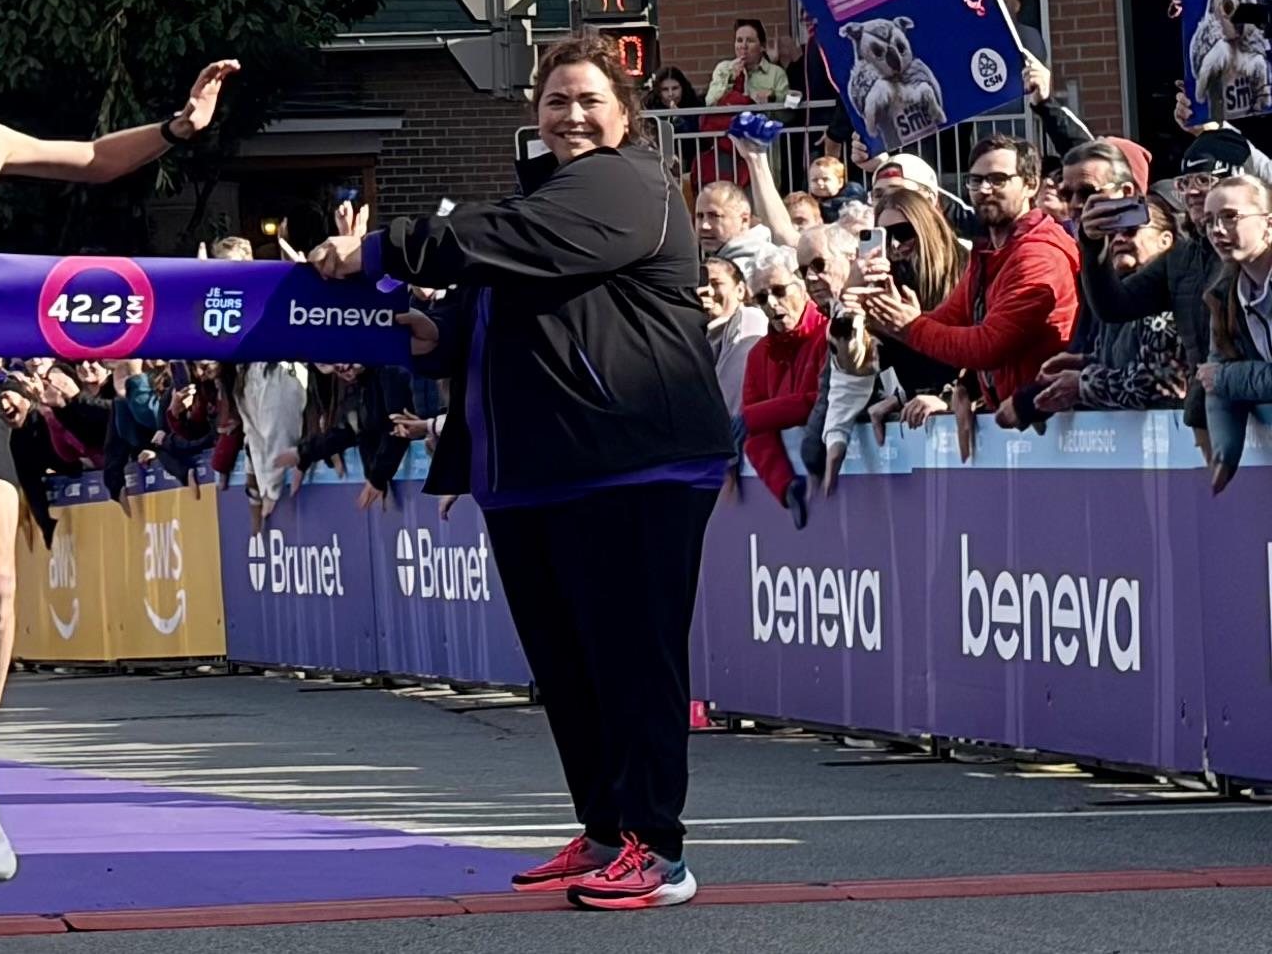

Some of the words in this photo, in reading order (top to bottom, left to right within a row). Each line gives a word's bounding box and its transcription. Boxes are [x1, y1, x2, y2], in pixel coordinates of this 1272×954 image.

[48, 293, 123, 324] 42.2
[125, 294, 145, 324] KM
[204, 298, 243, 309] COURS
[205, 287, 221, 298] JE
[288, 299, 394, 327] beneva
[203, 309, 242, 337] QC
[144, 518, 183, 582] aws
[269, 529, 344, 596] Brunet
[417, 528, 490, 602] Brunet
[750, 533, 883, 652] beneva
[961, 533, 1141, 673] beneva
